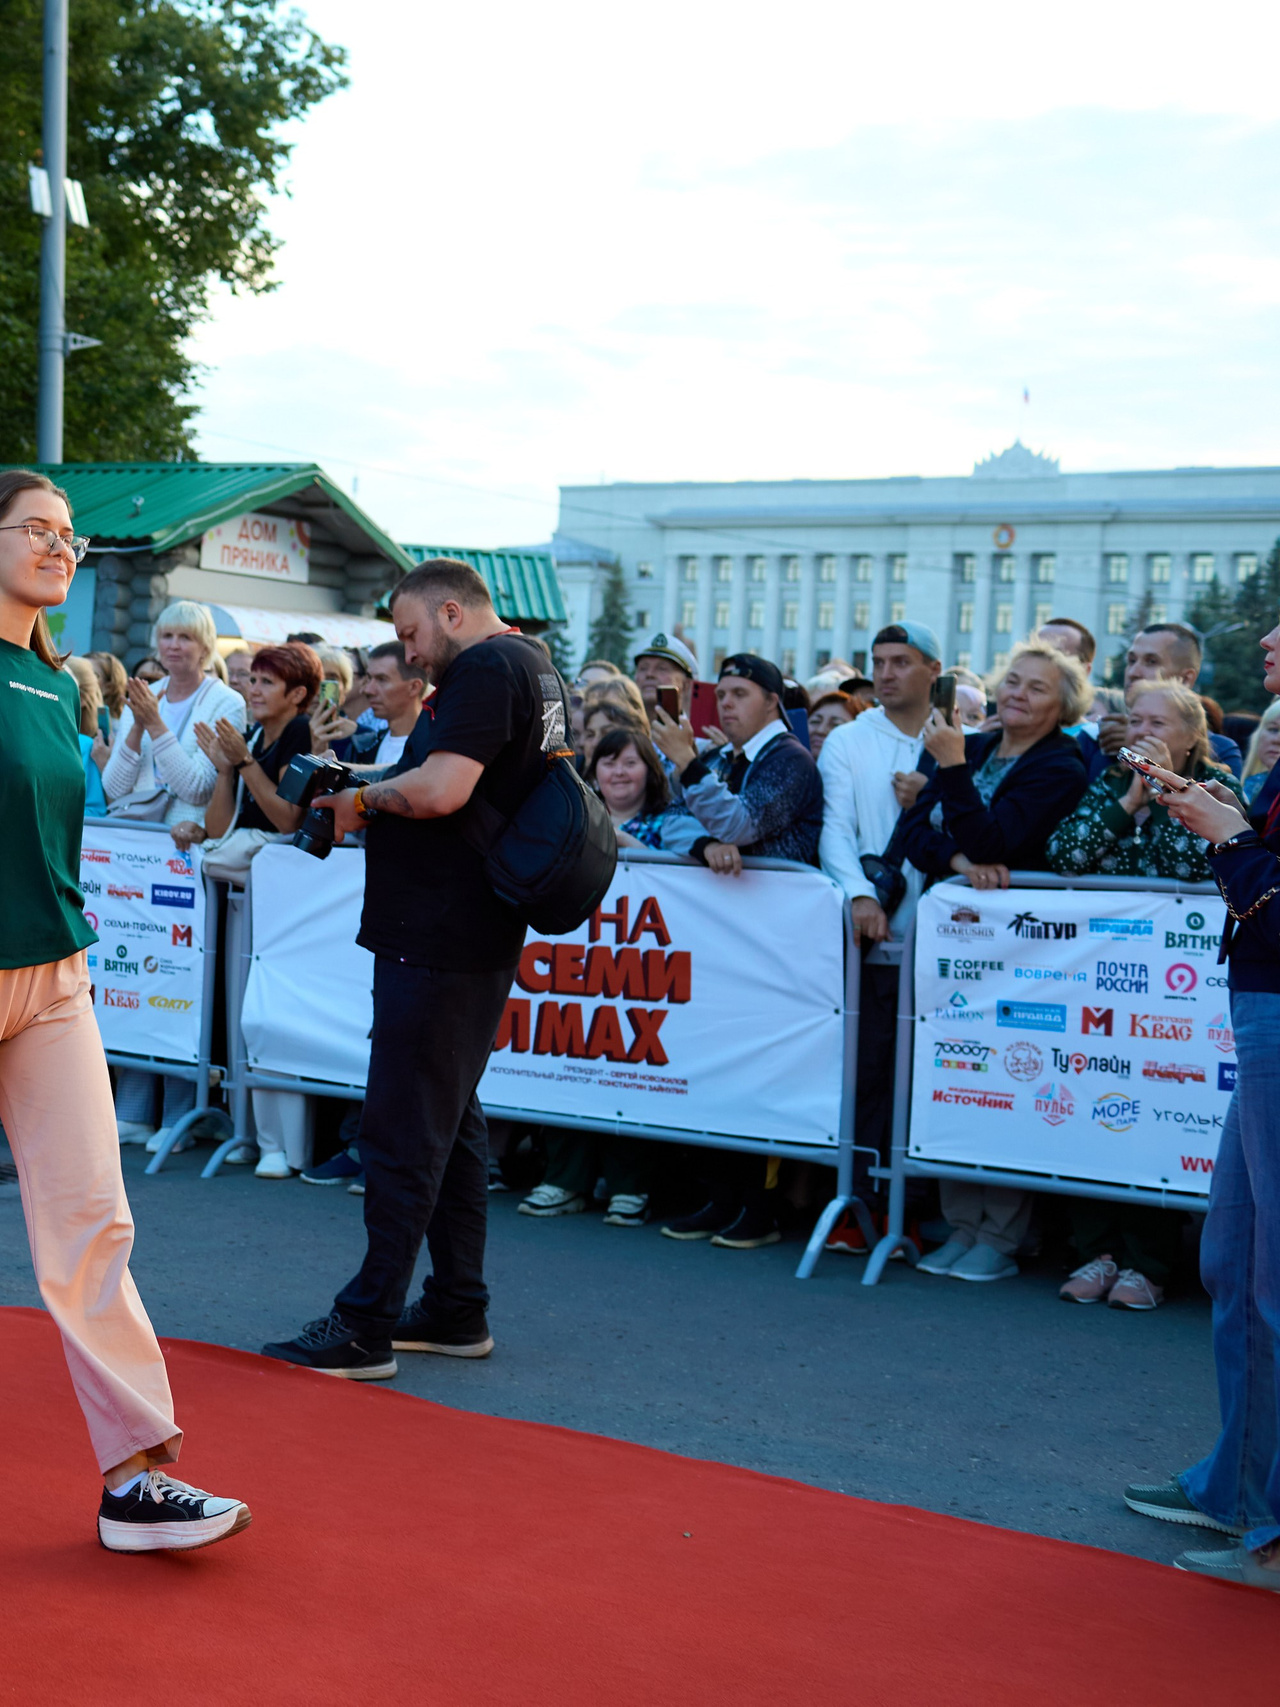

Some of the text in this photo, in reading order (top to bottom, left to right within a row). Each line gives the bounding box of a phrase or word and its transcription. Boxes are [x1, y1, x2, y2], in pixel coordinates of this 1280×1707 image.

[238, 518, 277, 543] ДОМ
[220, 544, 290, 575] ПРЯНИКА
[588, 895, 672, 947] НА
[937, 926, 995, 938] CHARUSHIN
[104, 958, 138, 976] ВЯТИЧ
[515, 941, 691, 1005] СЕМИ
[954, 959, 1004, 971] COFFEE
[1097, 961, 1148, 978] ПОЧТА
[954, 971, 982, 981] LIKE
[1096, 977, 1148, 994] РОССИИ
[934, 1008, 984, 1022] PATRON
[1013, 1012, 1062, 1022] ПРАВДА
[494, 997, 670, 1067] ЛМАХ
[934, 1042, 990, 1061] 700007
[564, 1065, 604, 1076] ПРЕЗИДЕНТ
[932, 1089, 1014, 1111] Источник
[1035, 1099, 1074, 1116] ПУЛЬС
[1092, 1100, 1141, 1120] МОРЕ
[1116, 1117, 1139, 1126] ПАРК
